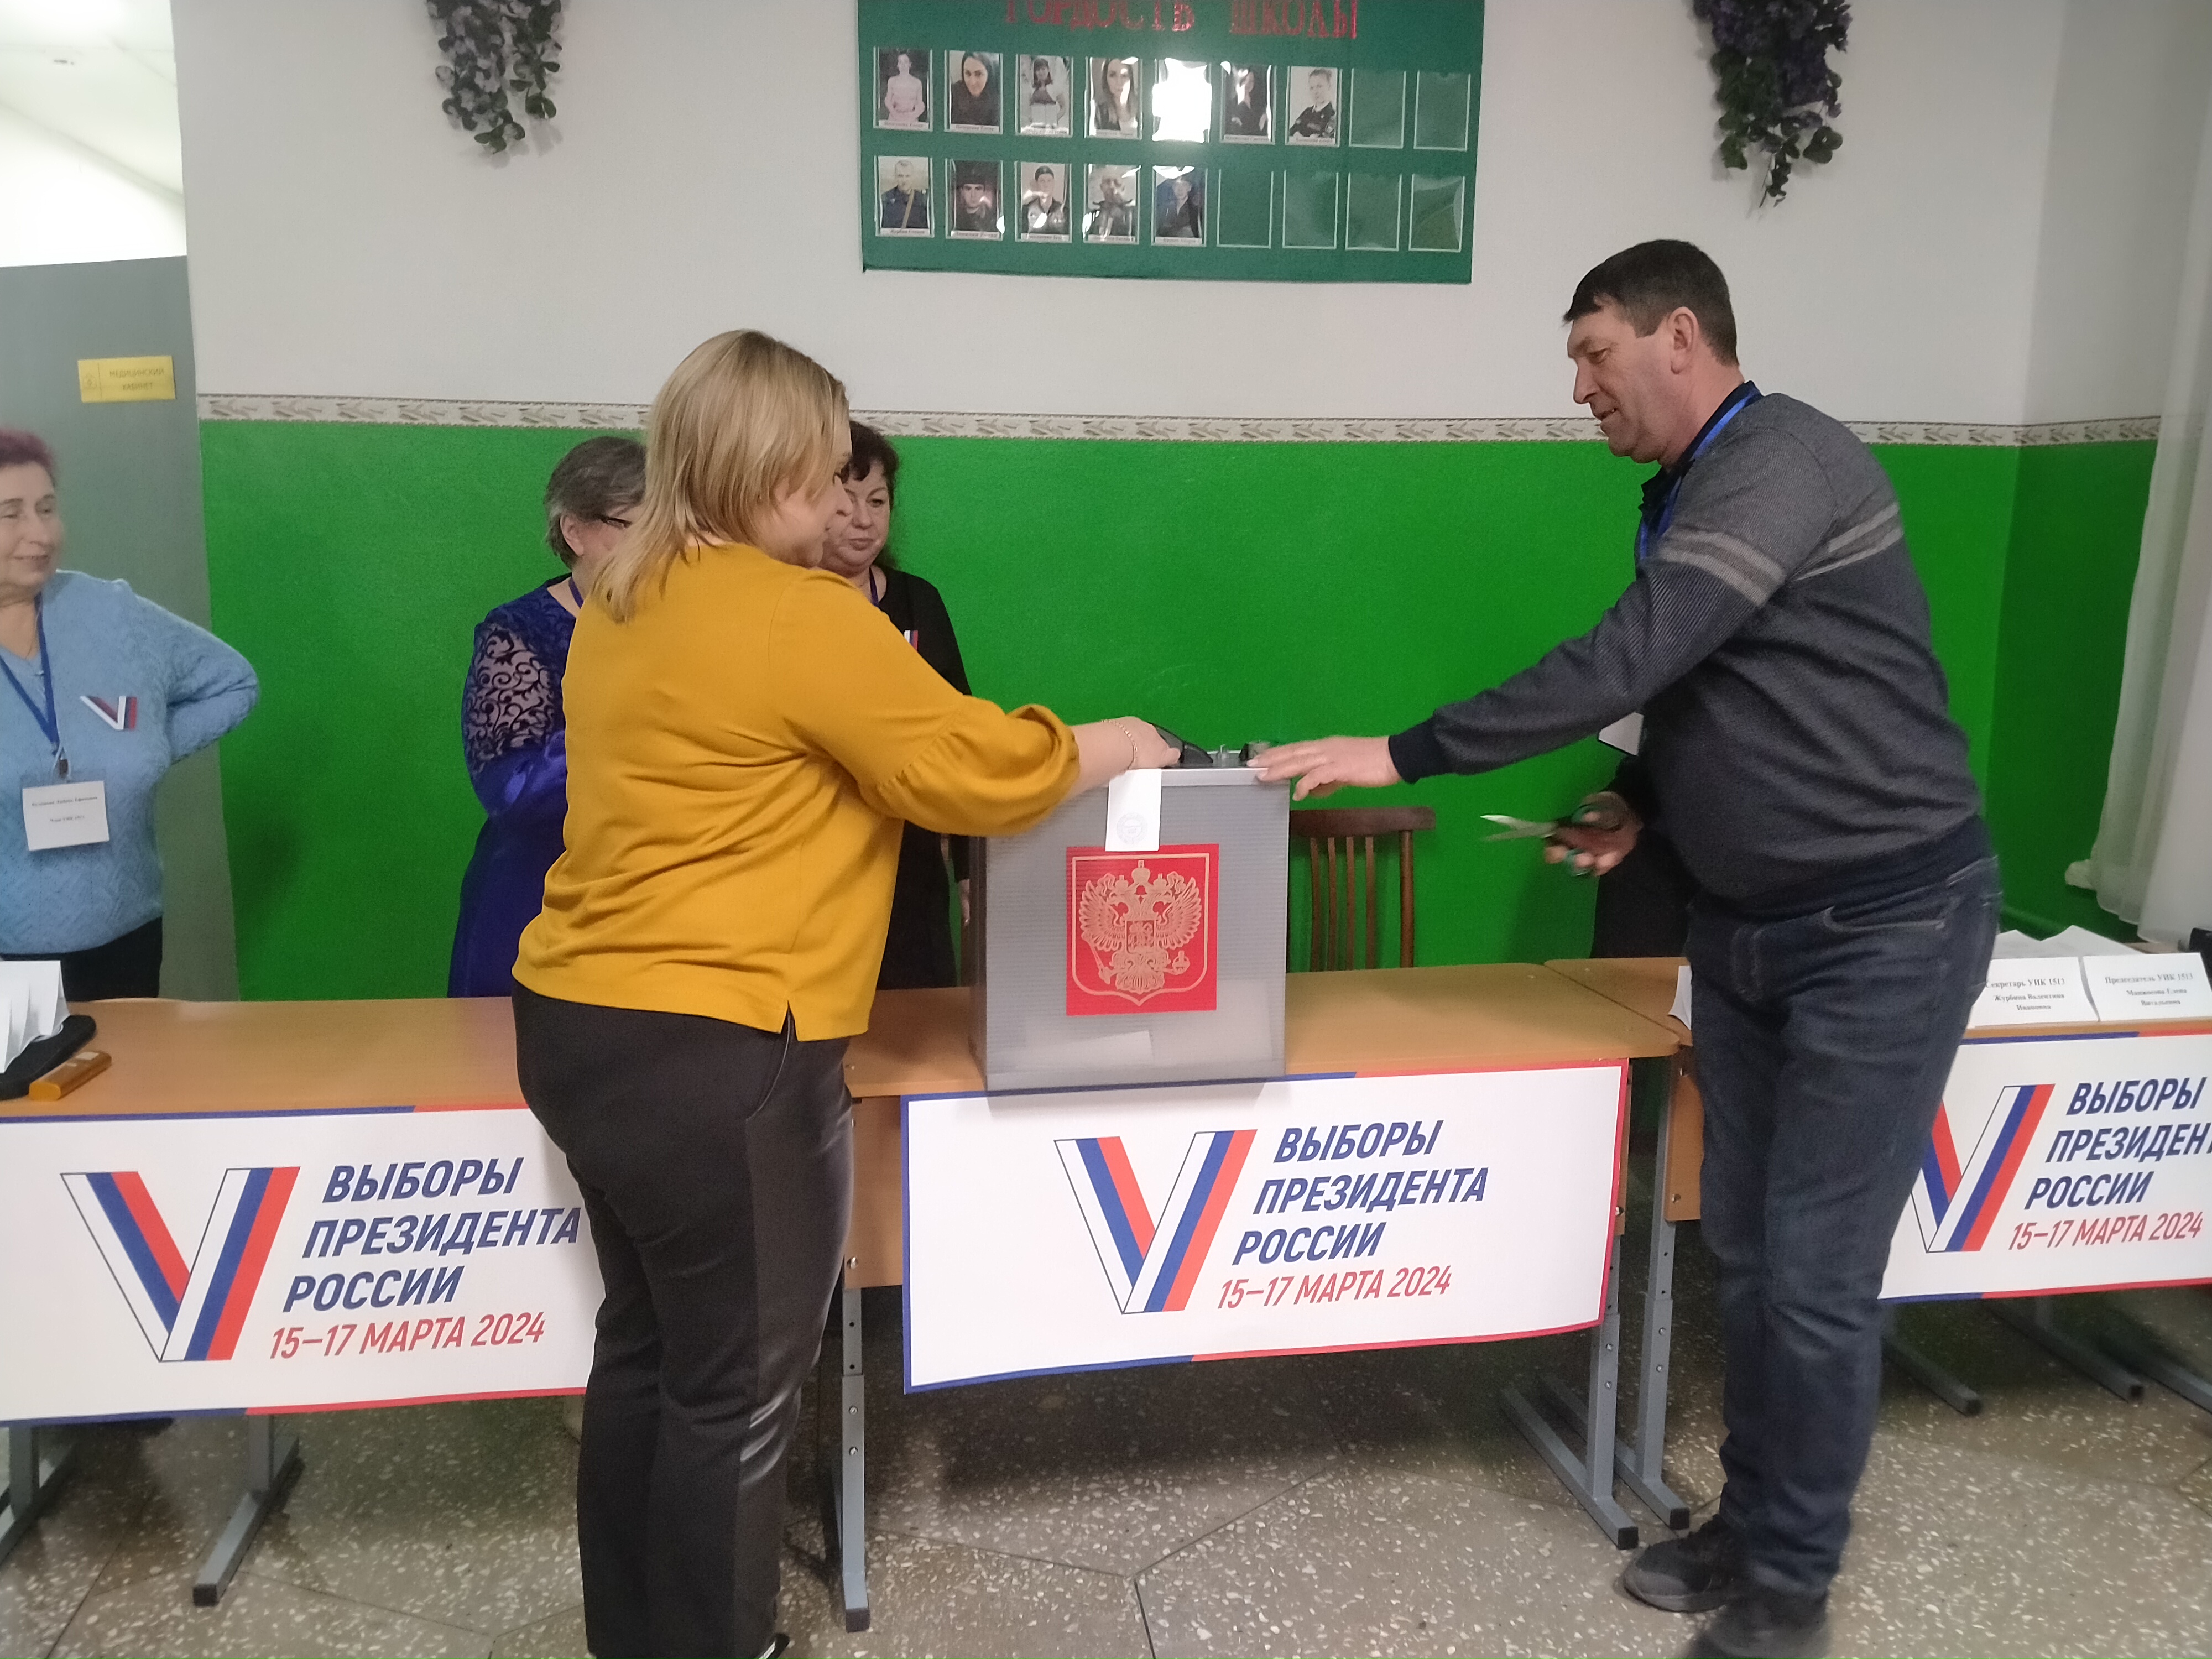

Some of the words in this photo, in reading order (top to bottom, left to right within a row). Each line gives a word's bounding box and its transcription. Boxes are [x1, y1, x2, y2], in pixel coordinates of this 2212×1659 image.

[2028, 978, 2046, 987] УИК
[2049, 978, 2065, 986] 1513
[2066, 1077, 2208, 1115] ВЫБОРЫ
[1274, 1120, 1444, 1163] ВЫБОРЫ
[2045, 1122, 2212, 1162] ПРЕЗИДЕН
[322, 1157, 525, 1203] ВЫБОРЫ
[1253, 1167, 1488, 1214] ПРЕЗИДЕНТА
[2024, 1171, 2154, 1210] РОССИИ
[302, 1207, 582, 1259] ПРЕЗИДЕНТА
[1232, 1222, 1386, 1265] РОССИИ
[2072, 1214, 2148, 1246] МАРТА
[2148, 1211, 2203, 1241] 2024
[283, 1266, 465, 1313] РОССИИ
[1293, 1269, 1384, 1305] МАРТА
[1387, 1265, 1452, 1298] 2024
[359, 1316, 465, 1355] МАРТА
[471, 1312, 546, 1347] 2024
